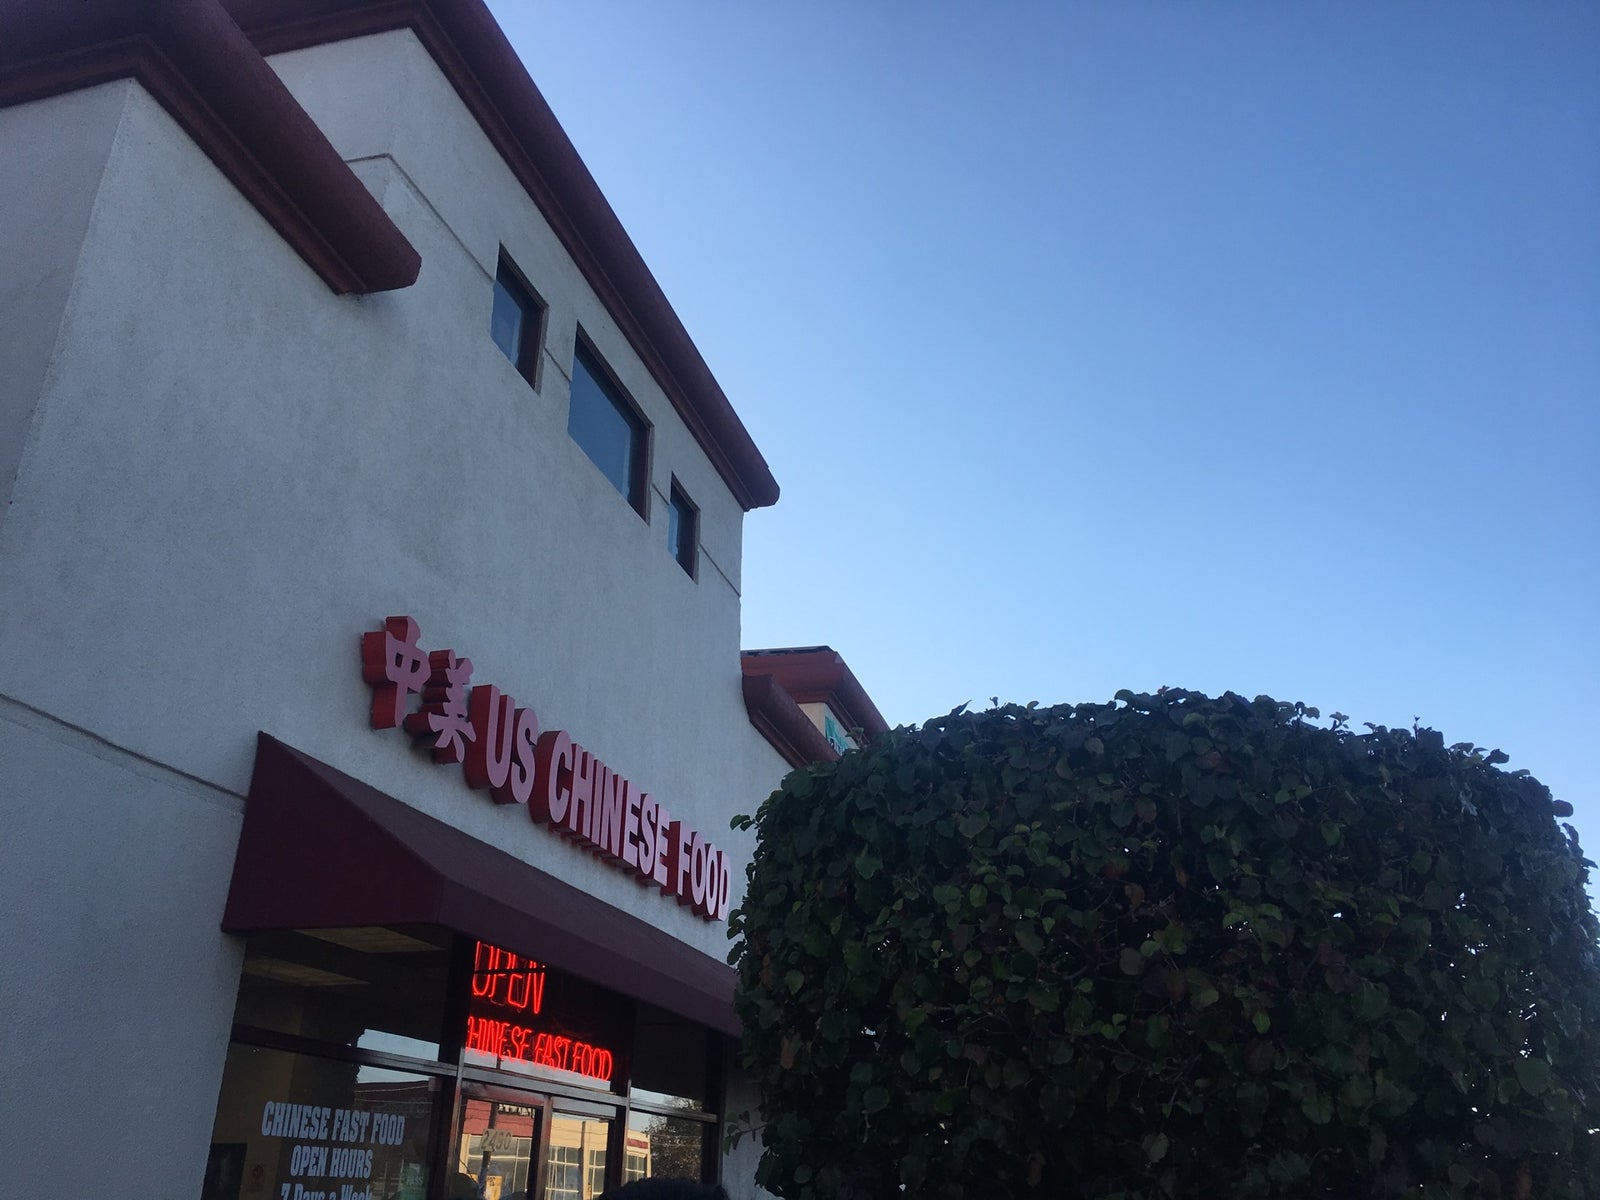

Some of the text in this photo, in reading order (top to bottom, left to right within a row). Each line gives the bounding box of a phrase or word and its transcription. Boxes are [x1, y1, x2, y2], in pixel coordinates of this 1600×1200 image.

[368, 615, 477, 764] 中美
[477, 684, 731, 922] US CHINESE FOOD
[472, 940, 547, 1015] OPEN
[466, 1016, 613, 1082] HINESE FAST FOOD
[261, 1101, 405, 1146] CHINESE FAST FOOD
[290, 1145, 374, 1179] OPEN HOURS
